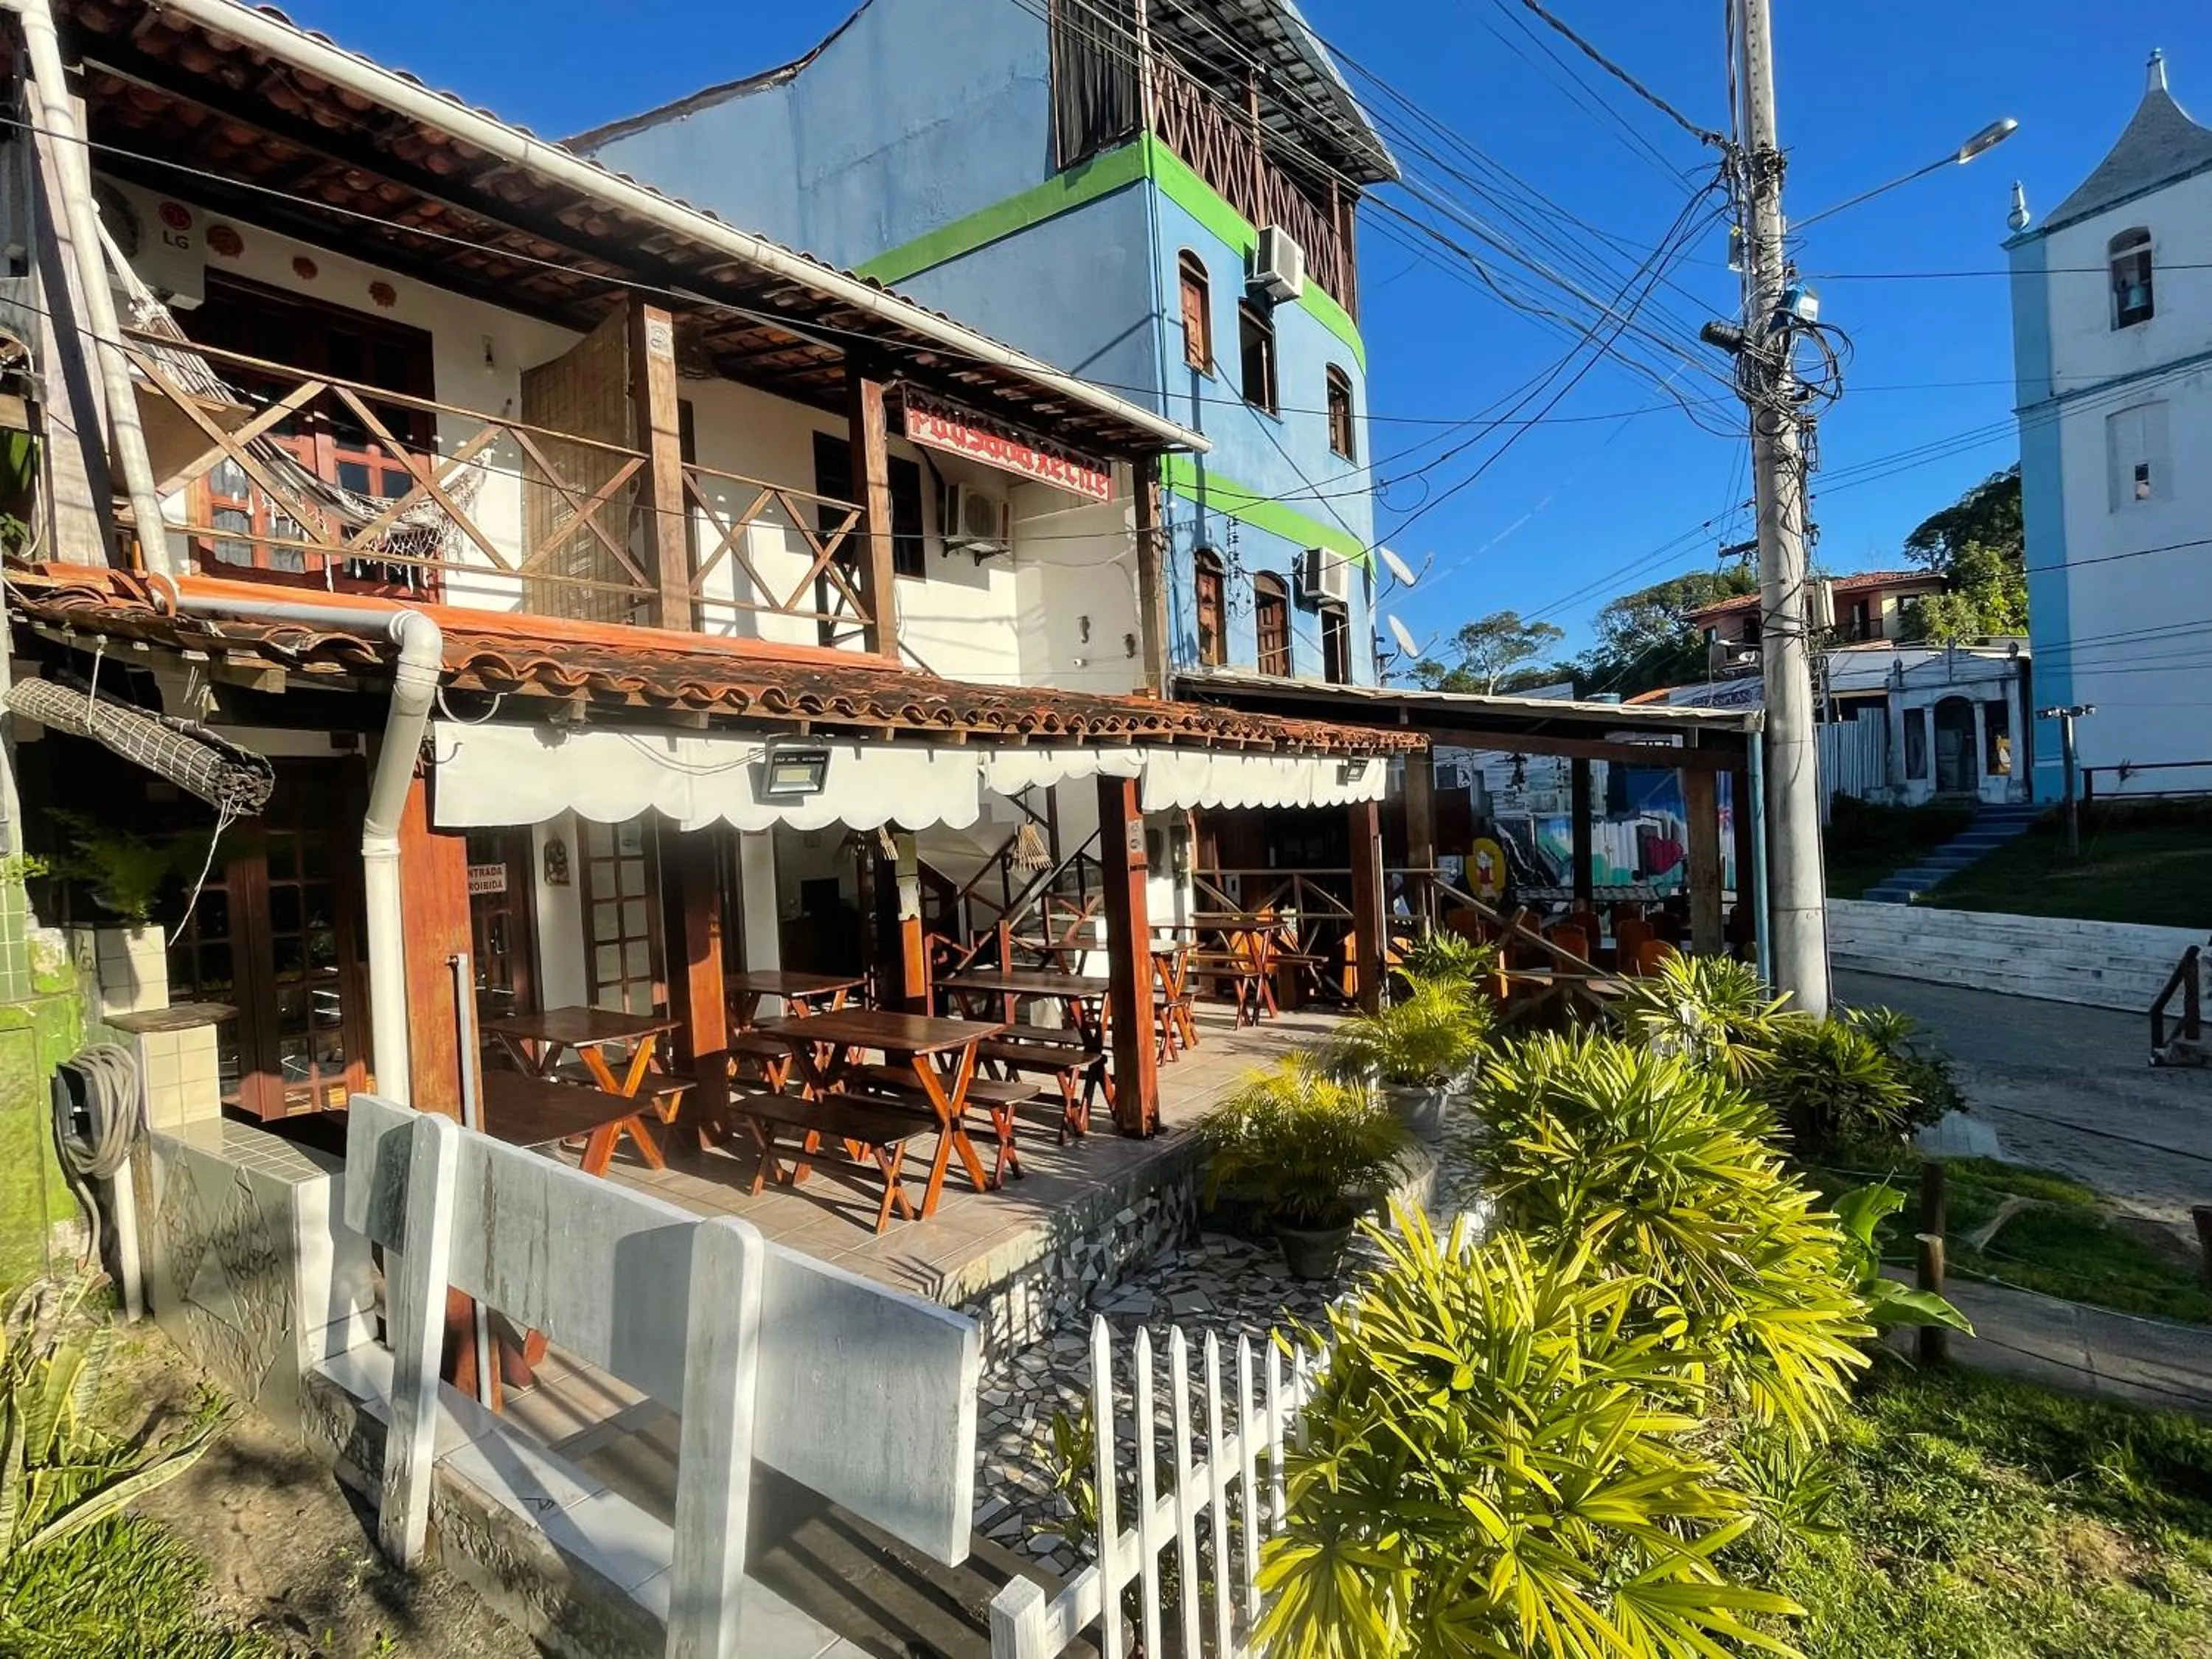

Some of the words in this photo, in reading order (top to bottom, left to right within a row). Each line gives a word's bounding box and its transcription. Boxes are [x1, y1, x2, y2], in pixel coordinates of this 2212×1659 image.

[163, 230, 189, 250] LG
[467, 866, 502, 878] NTRADA
[468, 880, 503, 891] ROIBIDA
